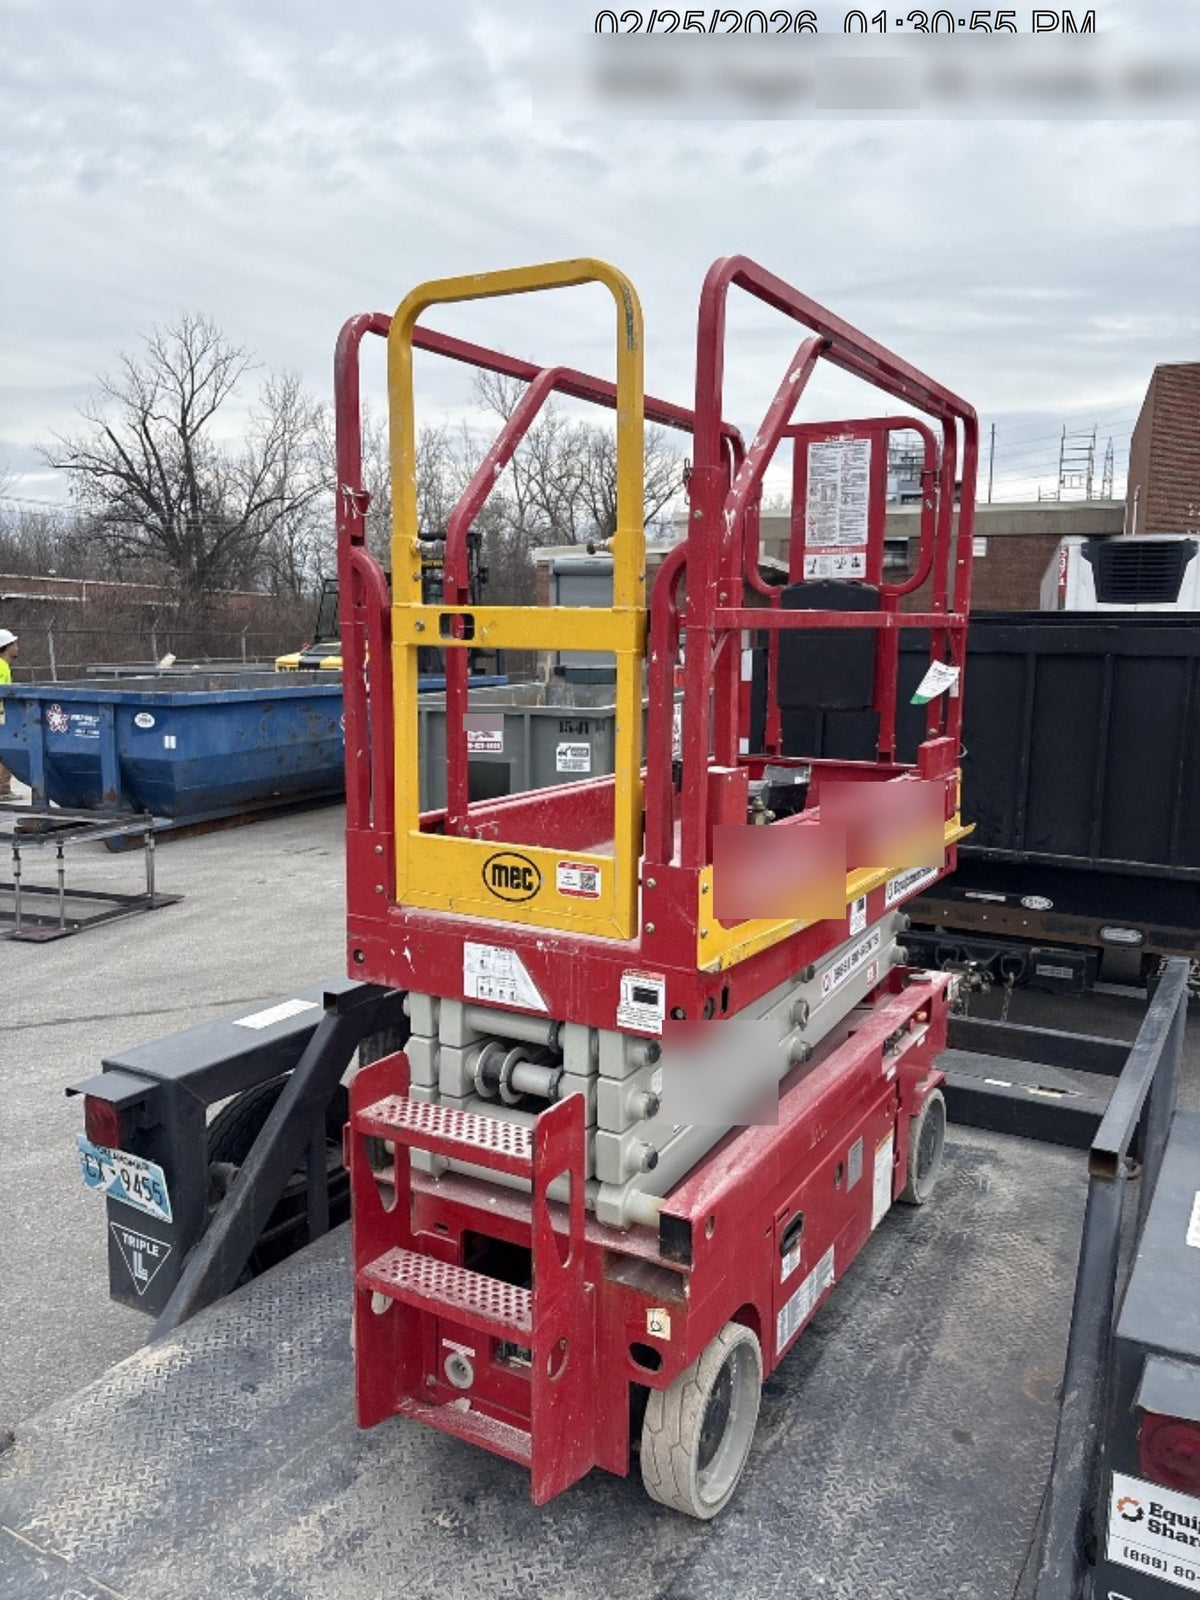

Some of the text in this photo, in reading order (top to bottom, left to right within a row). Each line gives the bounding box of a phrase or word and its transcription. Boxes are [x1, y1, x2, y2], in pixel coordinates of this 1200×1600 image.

[120, 1168, 162, 1206] 9455
[122, 1232, 159, 1257] TRIPLE
[1148, 1502, 1200, 1534] Equi
[1147, 1519, 1200, 1547] Shar
[1123, 1546, 1168, 1572] (888)
